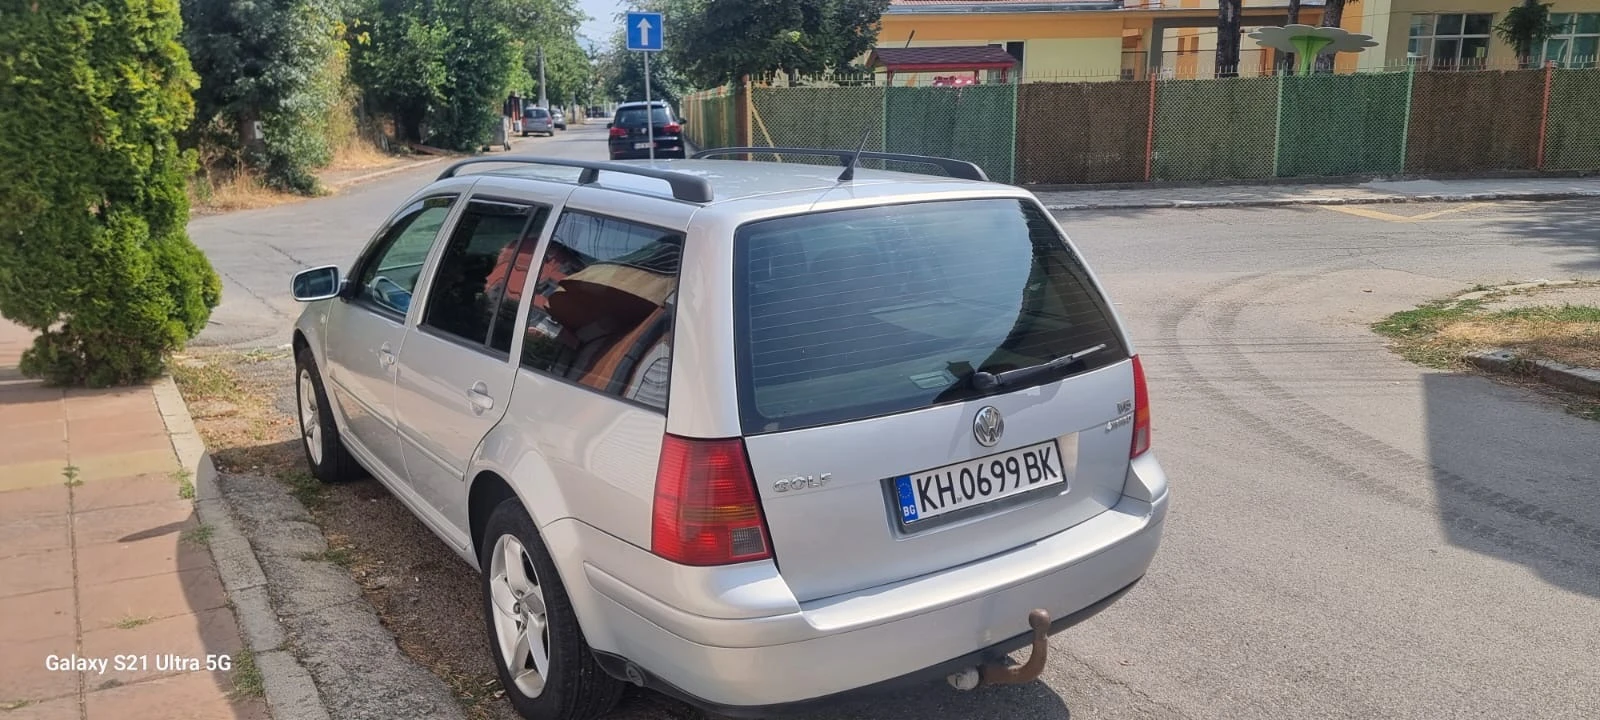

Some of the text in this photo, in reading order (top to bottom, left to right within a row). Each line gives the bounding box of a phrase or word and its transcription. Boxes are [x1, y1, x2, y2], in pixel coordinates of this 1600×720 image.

[974, 406, 1002, 446] VW
[773, 472, 832, 493] GOLF
[902, 504, 916, 517] BG
